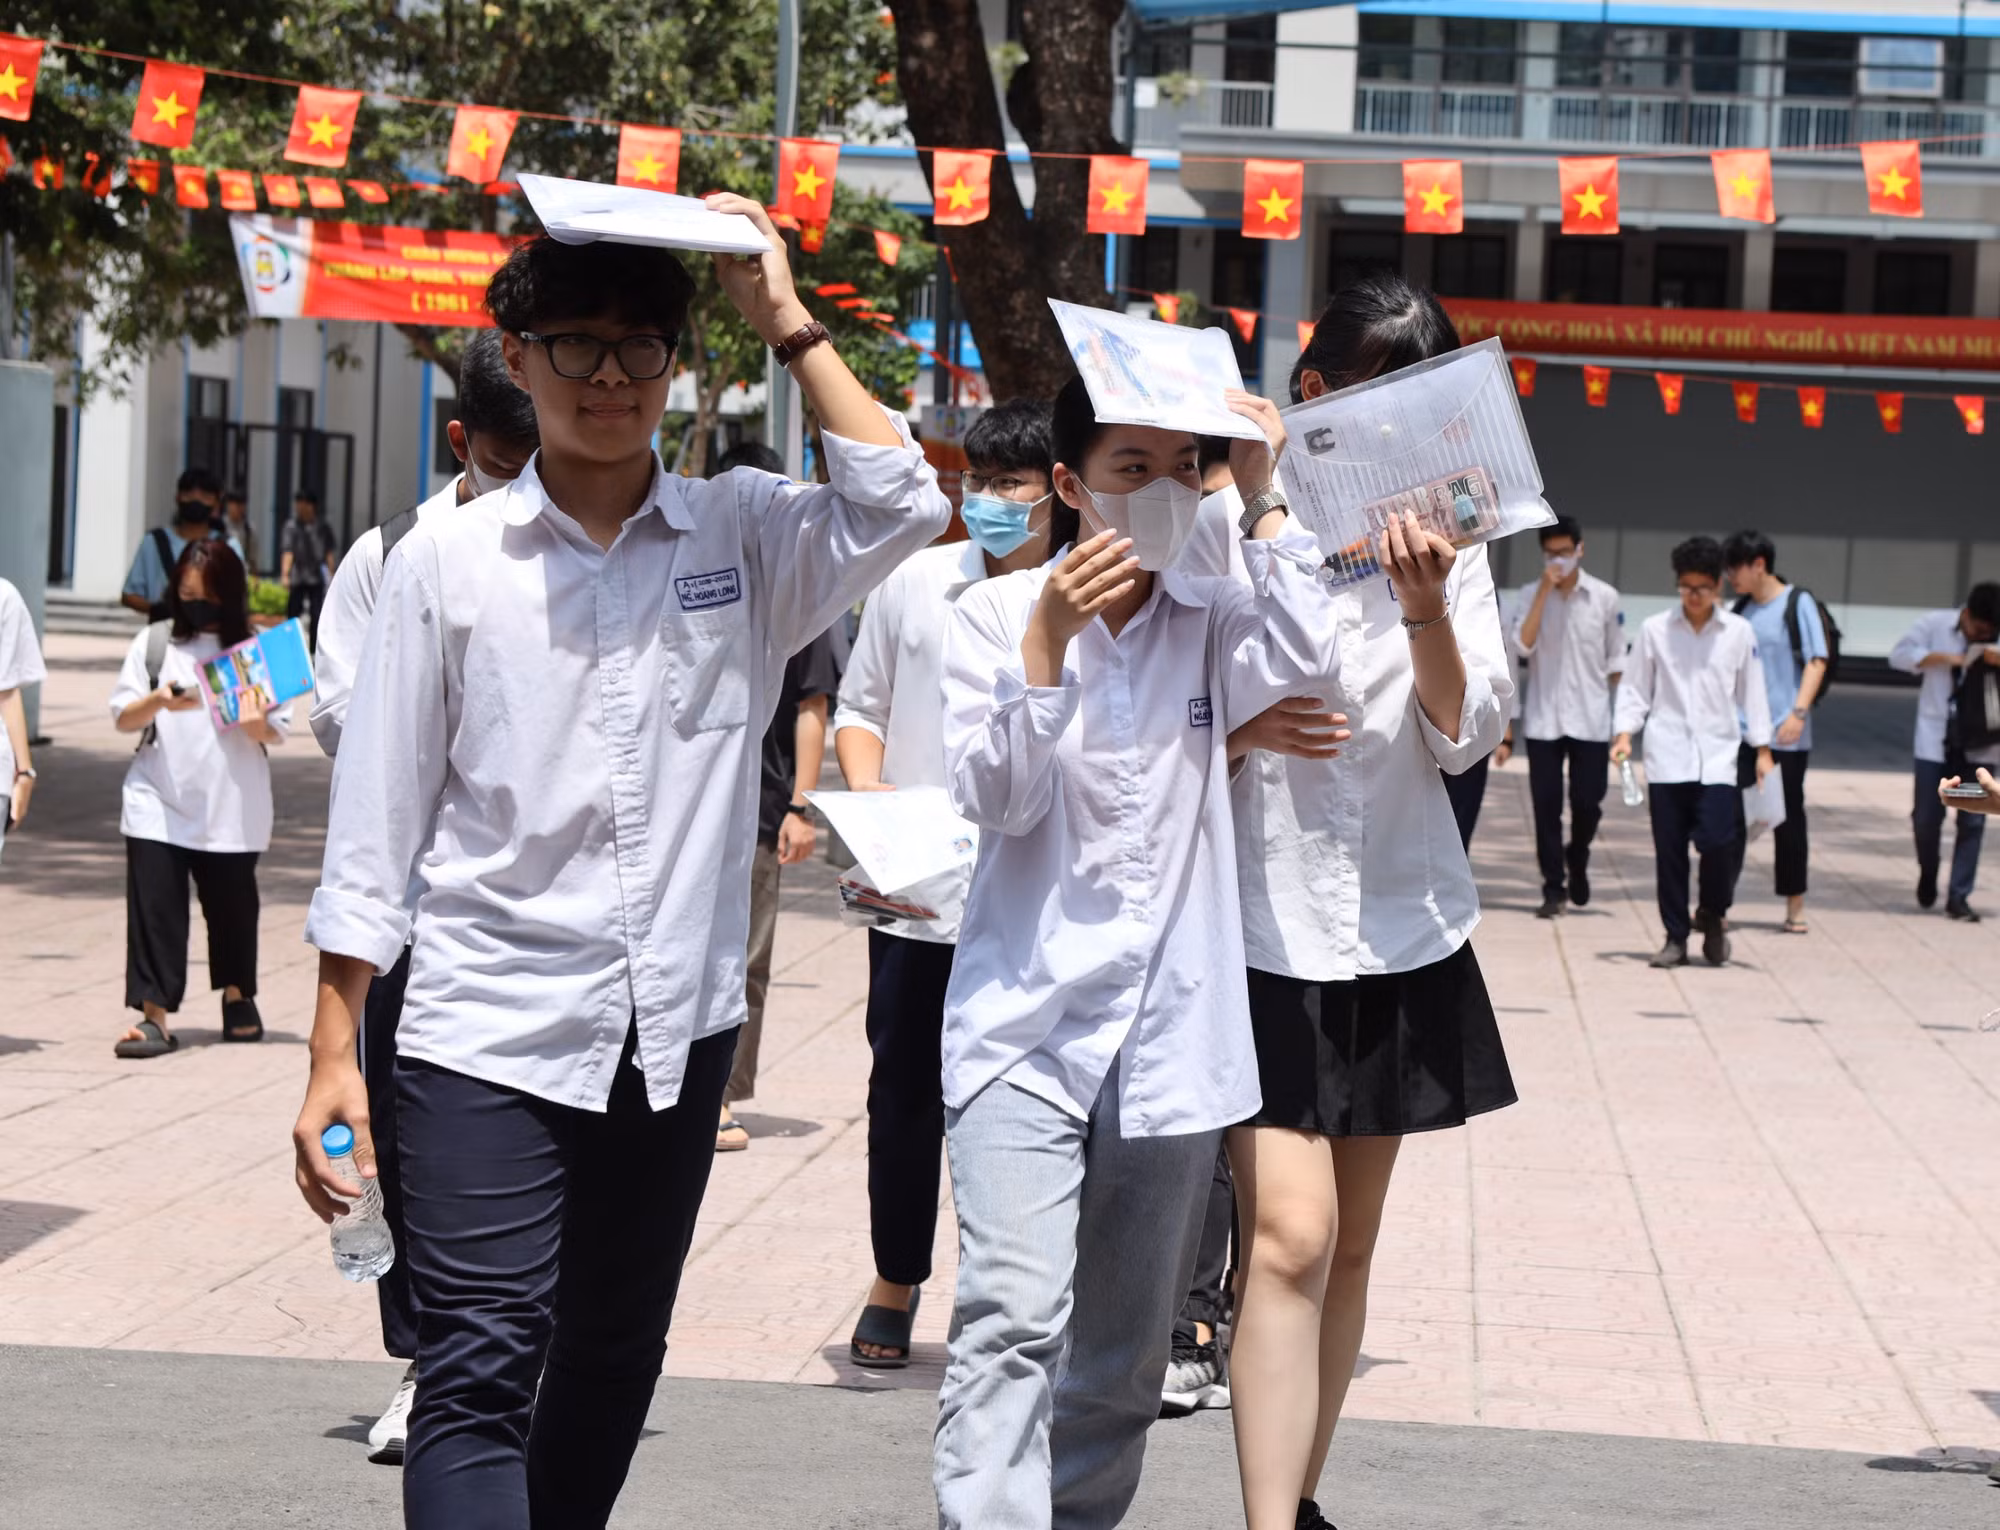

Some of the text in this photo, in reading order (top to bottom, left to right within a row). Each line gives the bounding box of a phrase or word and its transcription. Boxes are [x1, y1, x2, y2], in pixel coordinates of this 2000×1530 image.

[1495, 316, 1561, 343] CỘNG
[1659, 321, 1702, 350] HỘI
[1843, 328, 1898, 359] VIỆT
[1903, 332, 1957, 357] NAM
[1962, 335, 2000, 358] MU
[718, 584, 737, 597] LONG
